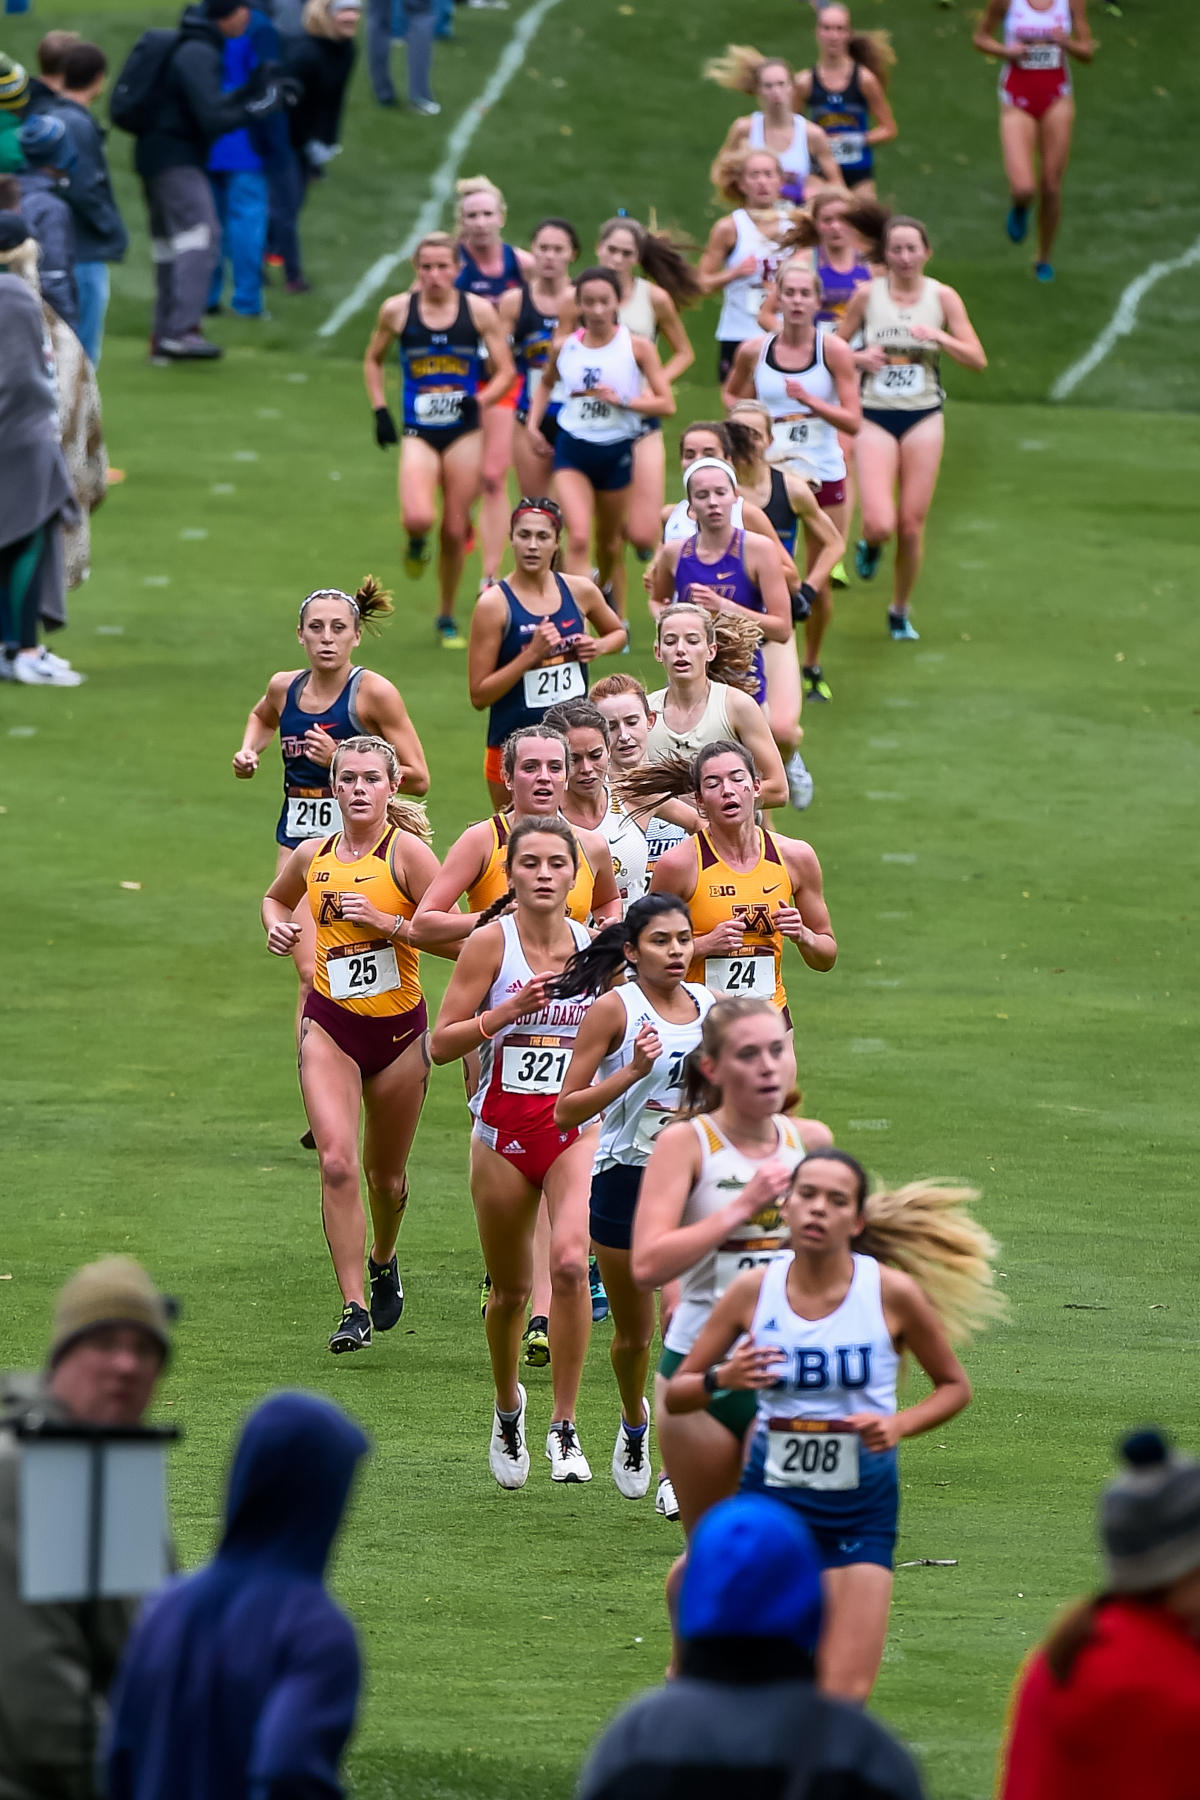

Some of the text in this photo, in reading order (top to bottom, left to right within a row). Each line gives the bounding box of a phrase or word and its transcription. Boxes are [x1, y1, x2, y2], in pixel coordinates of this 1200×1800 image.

[538, 667, 572, 695] 213
[296, 801, 332, 827] 216
[348, 955, 377, 988] 25
[726, 961, 756, 990] 24
[511, 1005, 550, 1026] OUTH
[517, 1051, 566, 1082] 321
[765, 1343, 871, 1391] BU
[782, 1438, 841, 1473] 208
